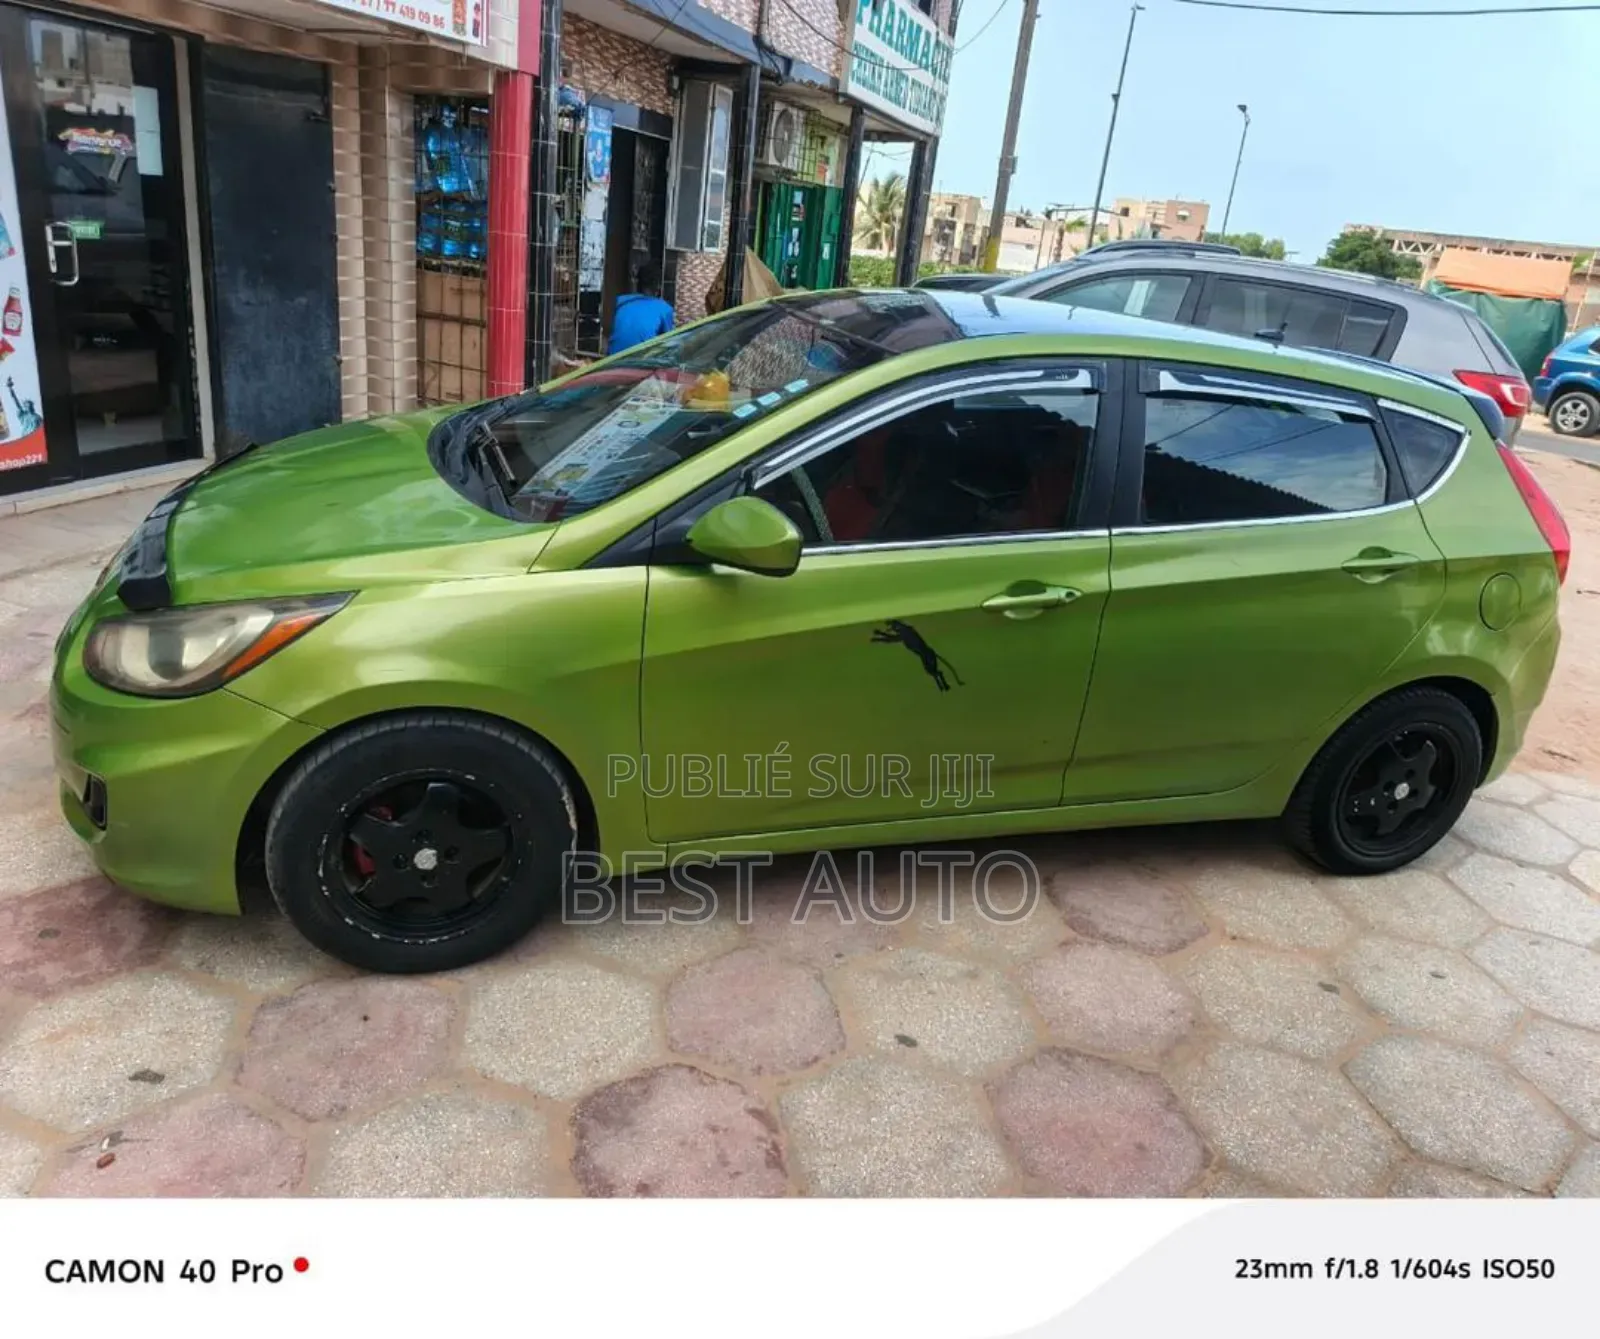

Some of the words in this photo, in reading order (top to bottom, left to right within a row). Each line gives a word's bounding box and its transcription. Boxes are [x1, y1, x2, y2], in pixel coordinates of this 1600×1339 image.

[400, 4, 415, 20] 419
[419, 10, 431, 24] 09
[856, 0, 952, 85] PHARMACIE
